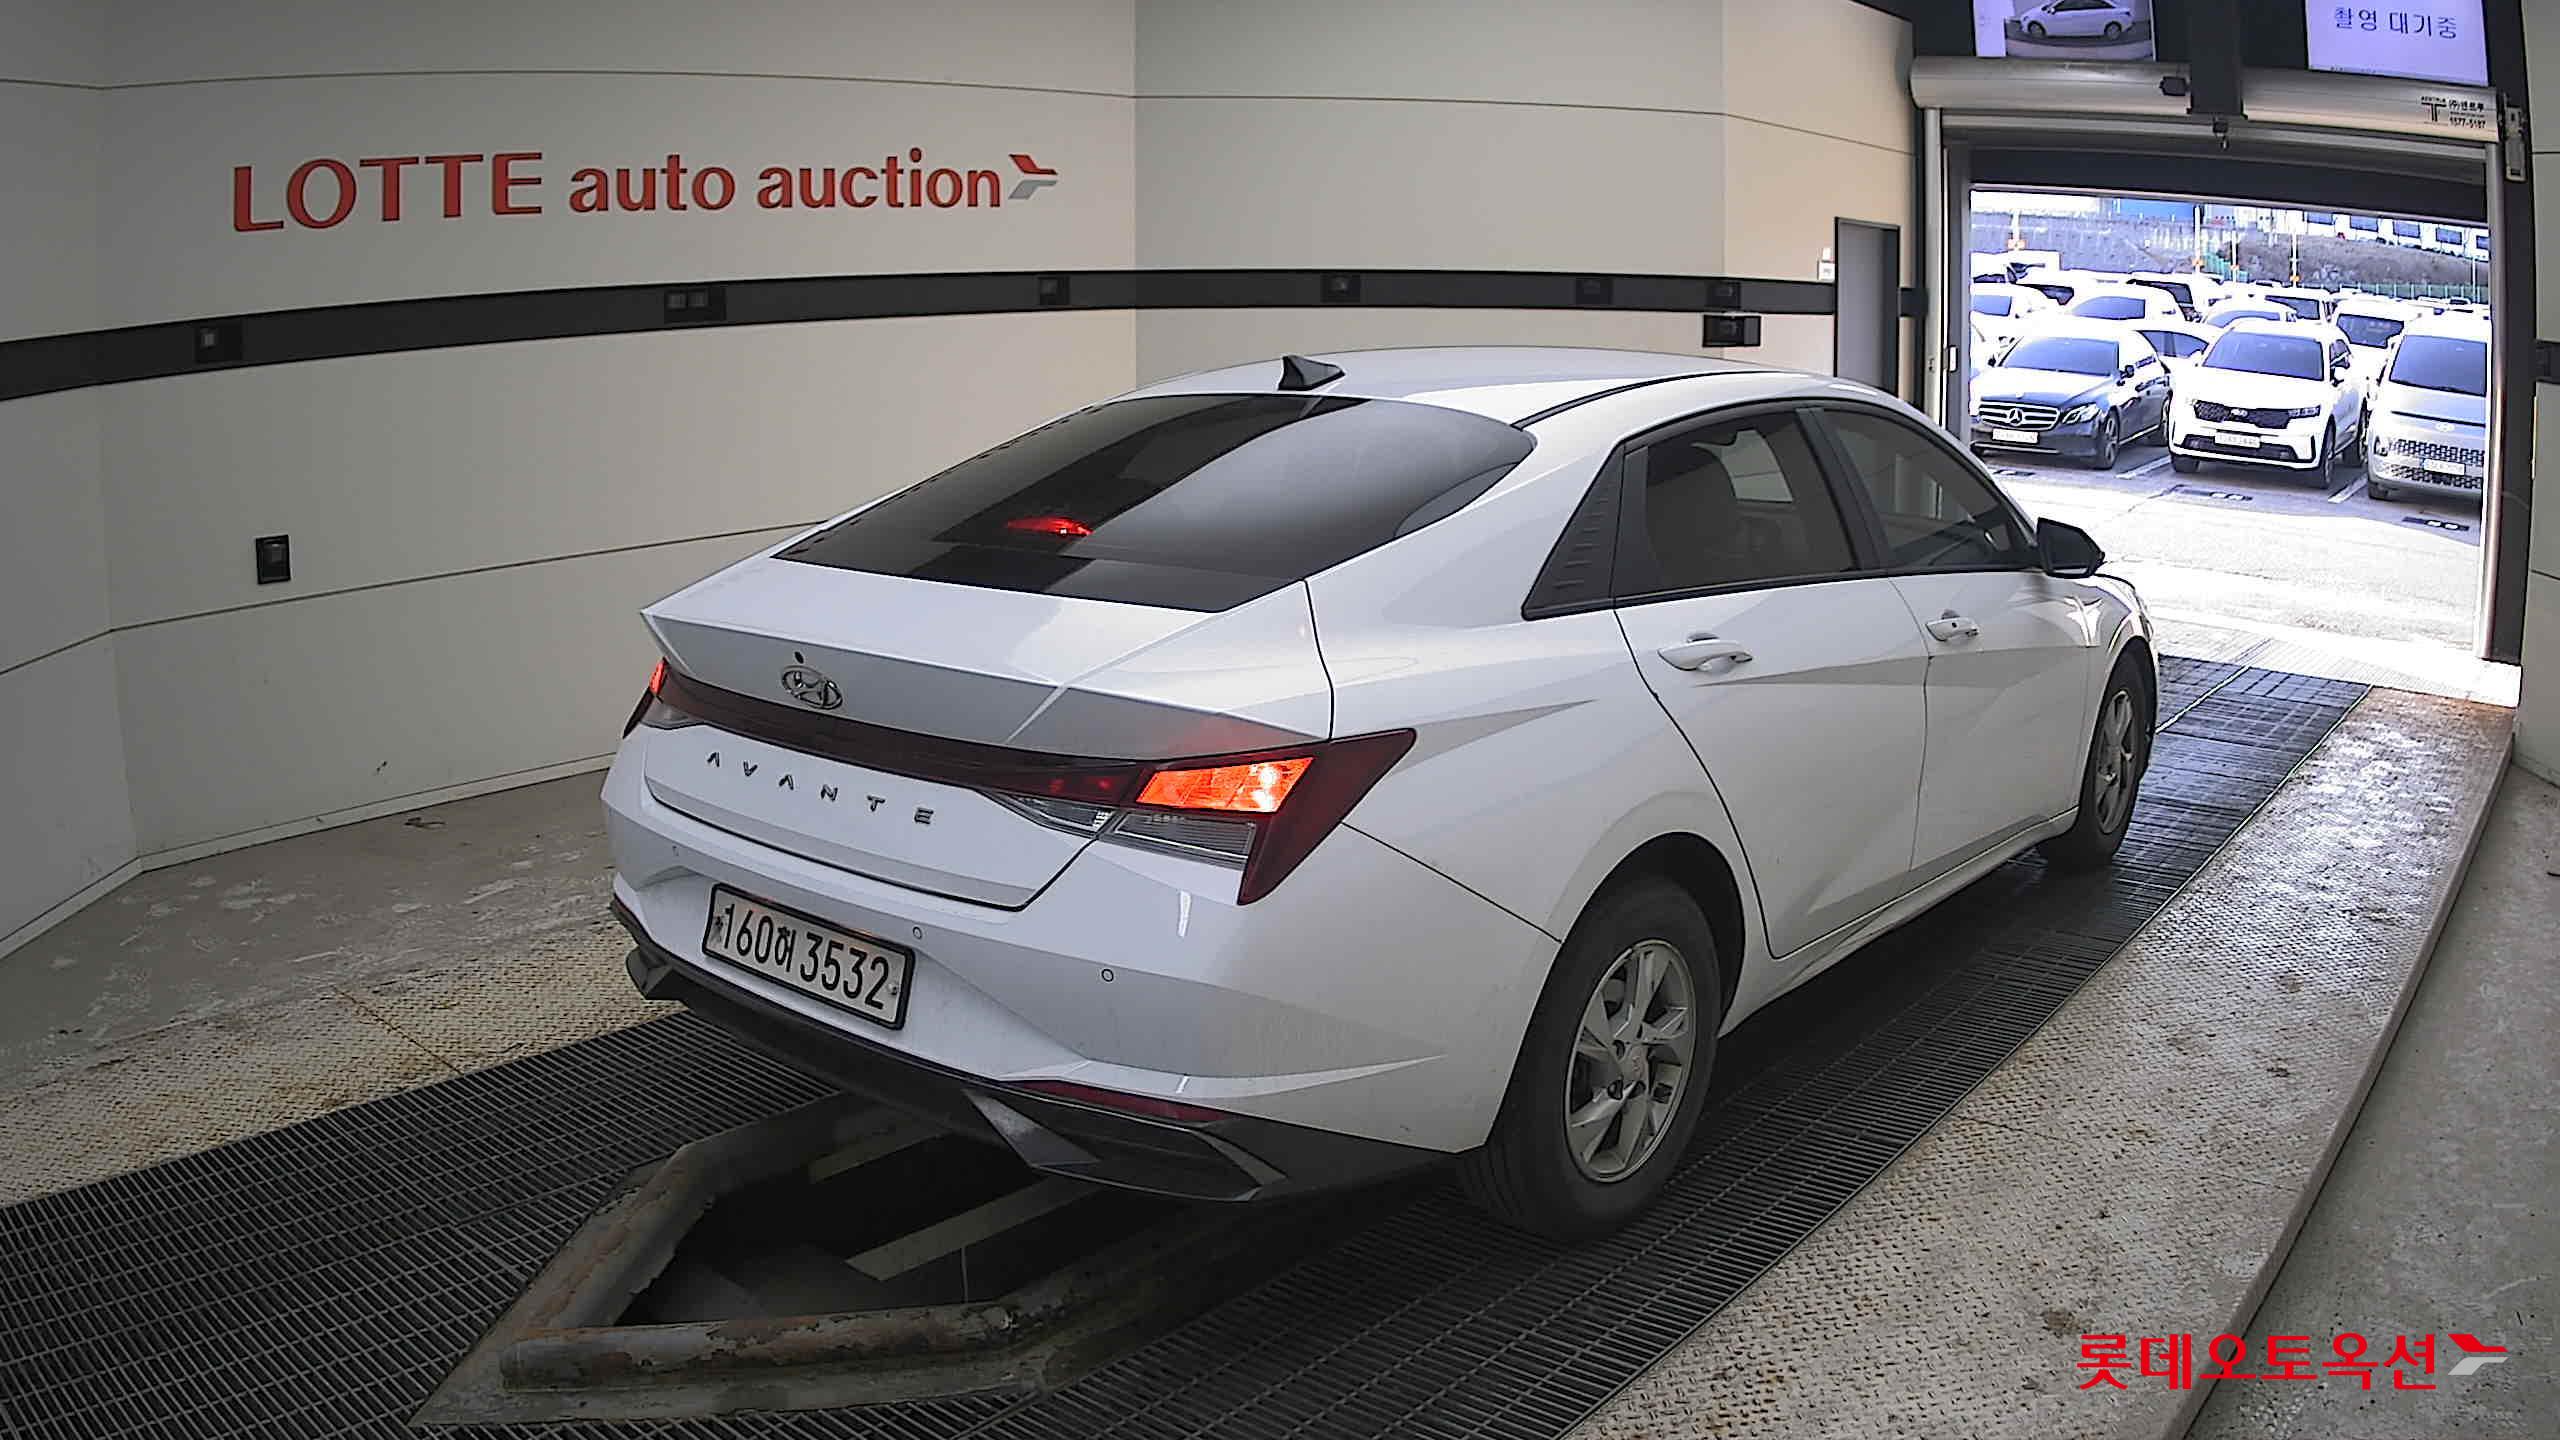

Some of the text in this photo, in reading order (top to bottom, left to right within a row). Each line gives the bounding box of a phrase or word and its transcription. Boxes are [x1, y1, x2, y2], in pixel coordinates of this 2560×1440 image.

[2336, 7, 2457, 39] 촬영 대기중
[234, 147, 1003, 232] LOTTE auto auction
[706, 751, 934, 825] AVANTE
[724, 903, 890, 1010] 160허 3532
